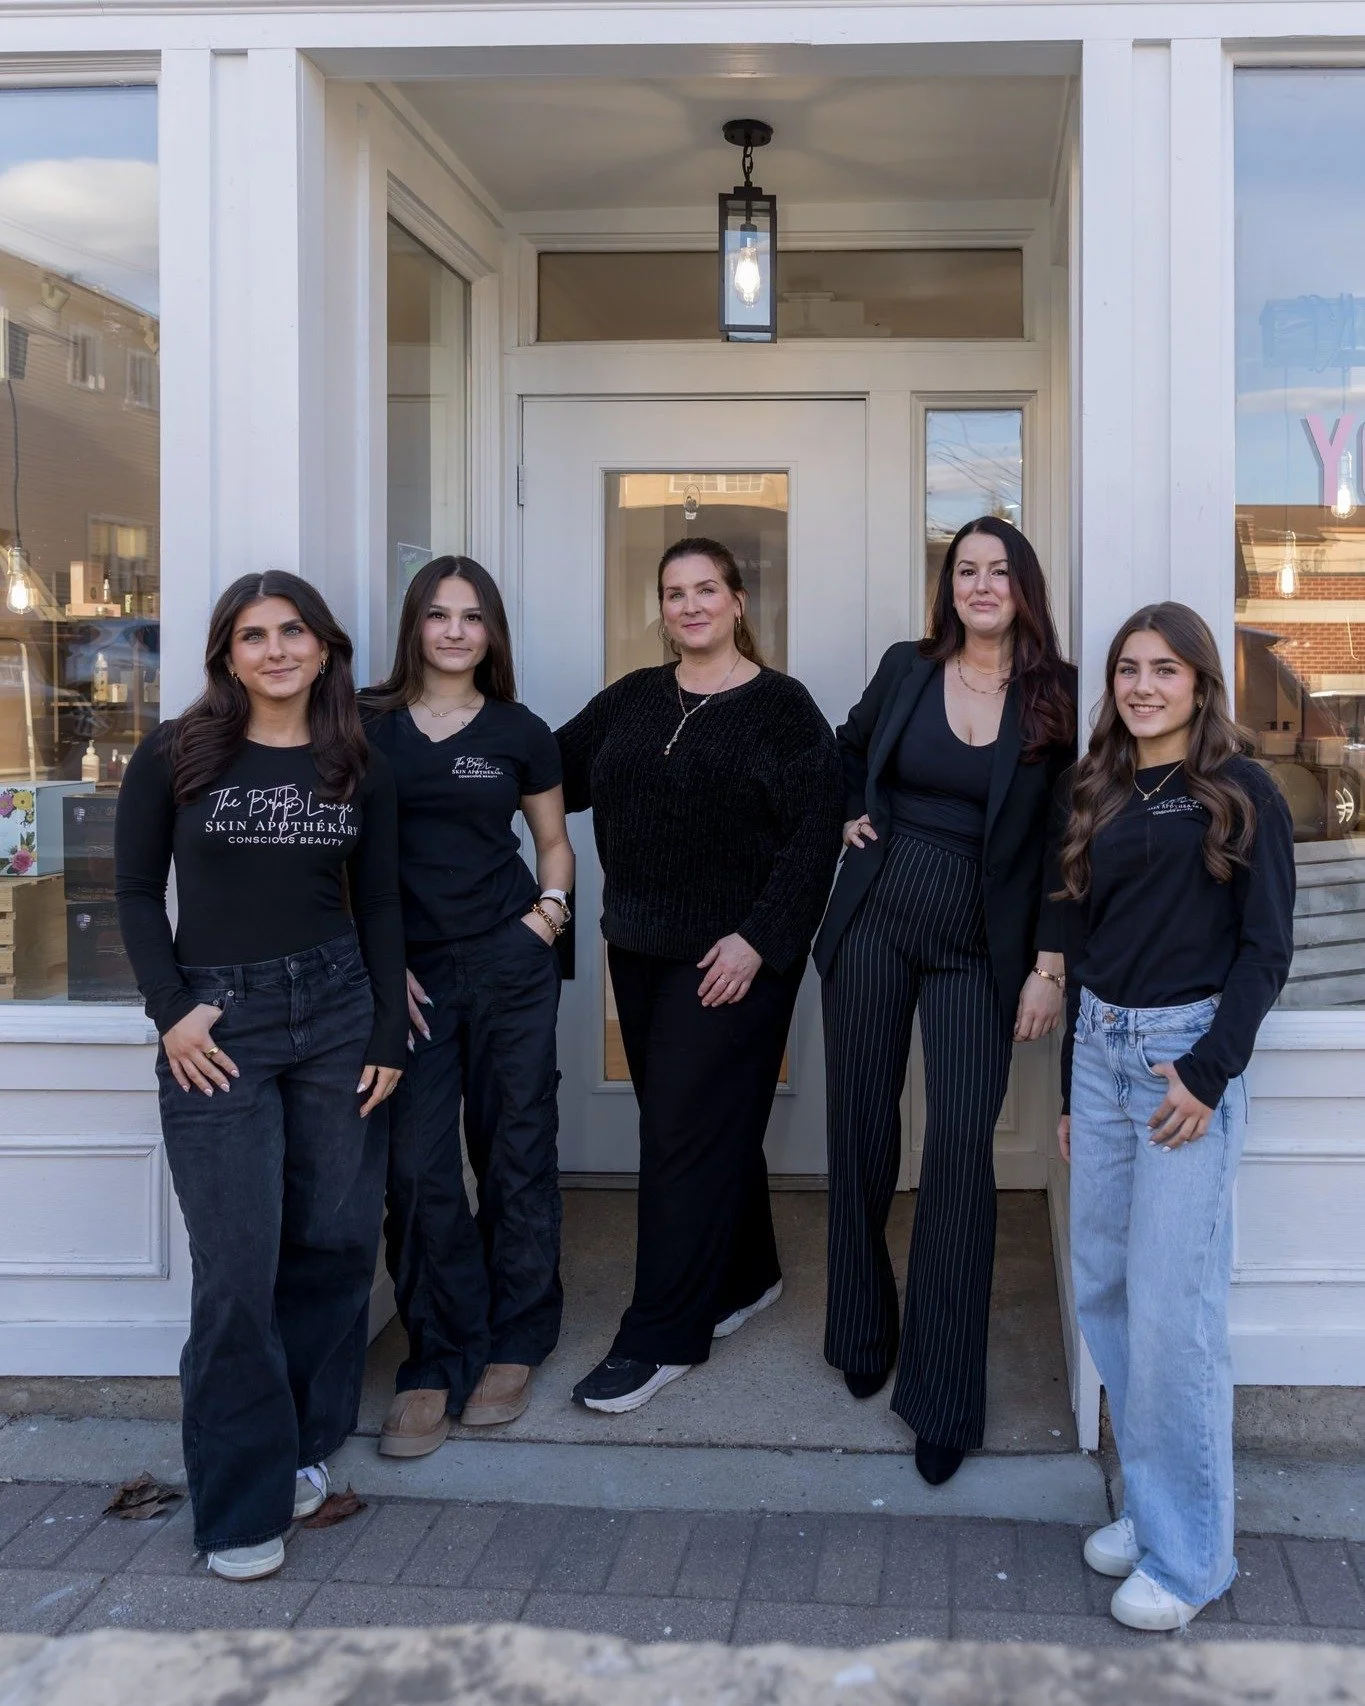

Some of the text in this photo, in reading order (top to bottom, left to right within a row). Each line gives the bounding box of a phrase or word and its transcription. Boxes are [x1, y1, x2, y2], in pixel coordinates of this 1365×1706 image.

[1300, 412, 1365, 507] Y
[209, 786, 242, 818] The
[306, 791, 354, 825] Lounge
[205, 820, 248, 833] SKIN
[228, 836, 344, 846] CONSCIOUS BEAUTY
